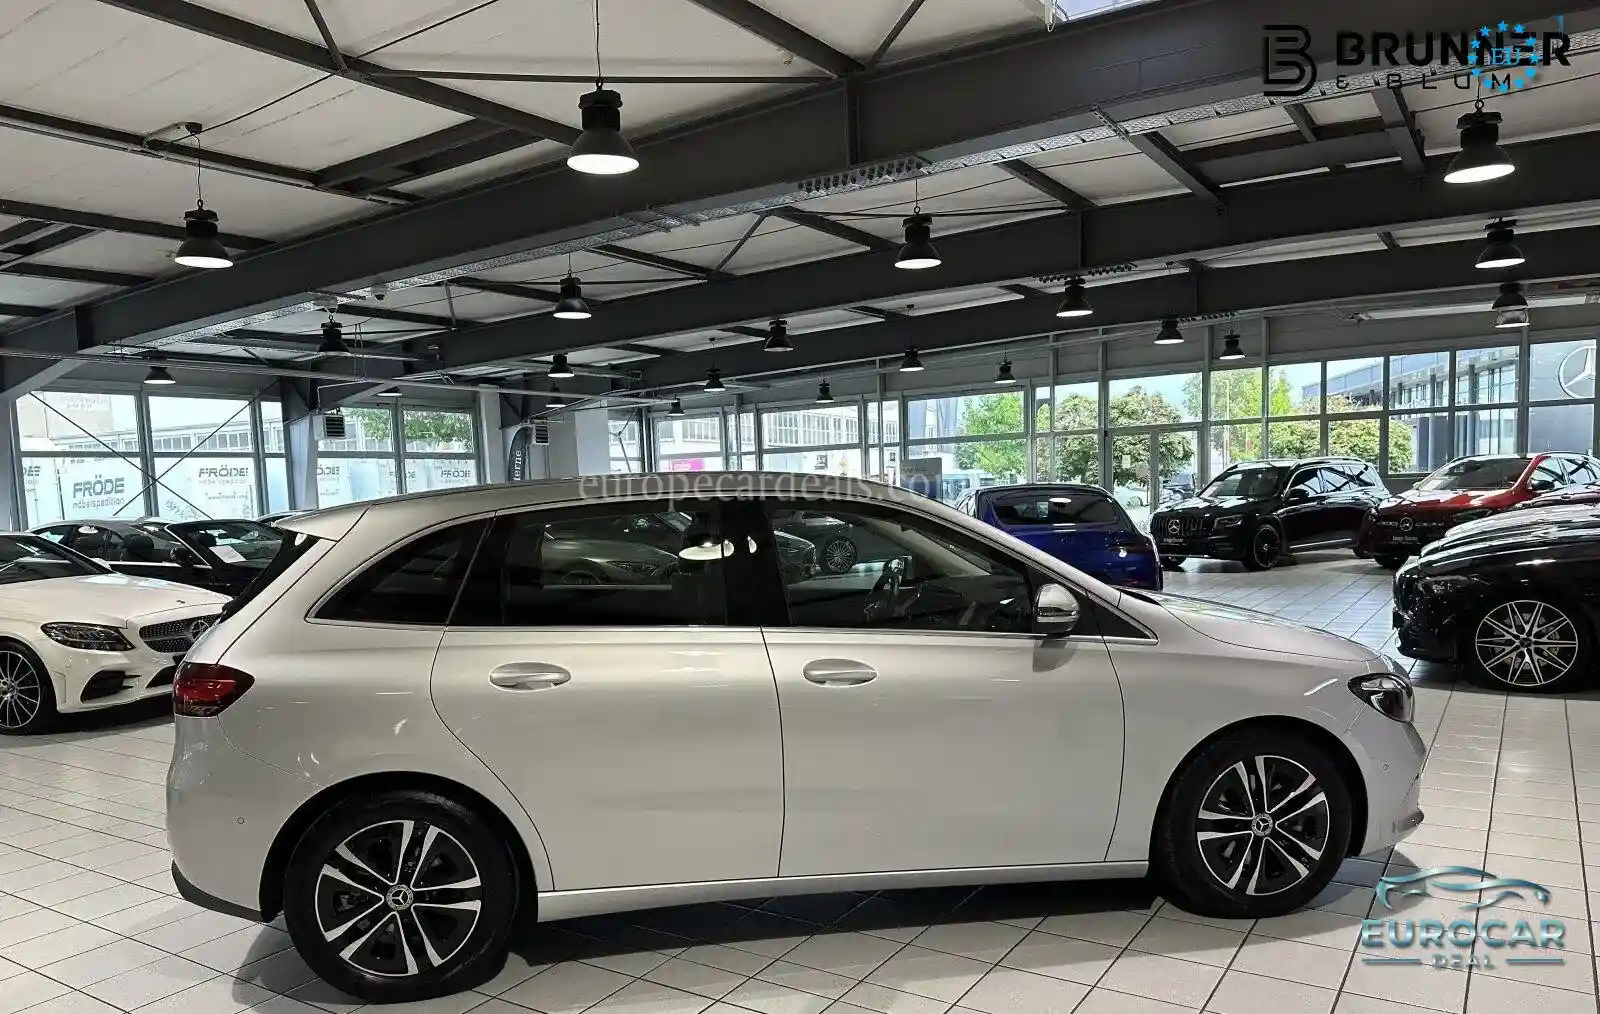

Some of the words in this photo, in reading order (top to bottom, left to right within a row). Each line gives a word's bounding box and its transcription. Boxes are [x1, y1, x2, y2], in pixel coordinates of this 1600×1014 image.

[198, 464, 249, 478] FRÖDE
[316, 464, 340, 476] ÖDE
[514, 450, 522, 481] terne
[73, 474, 125, 498] FRÖDE
